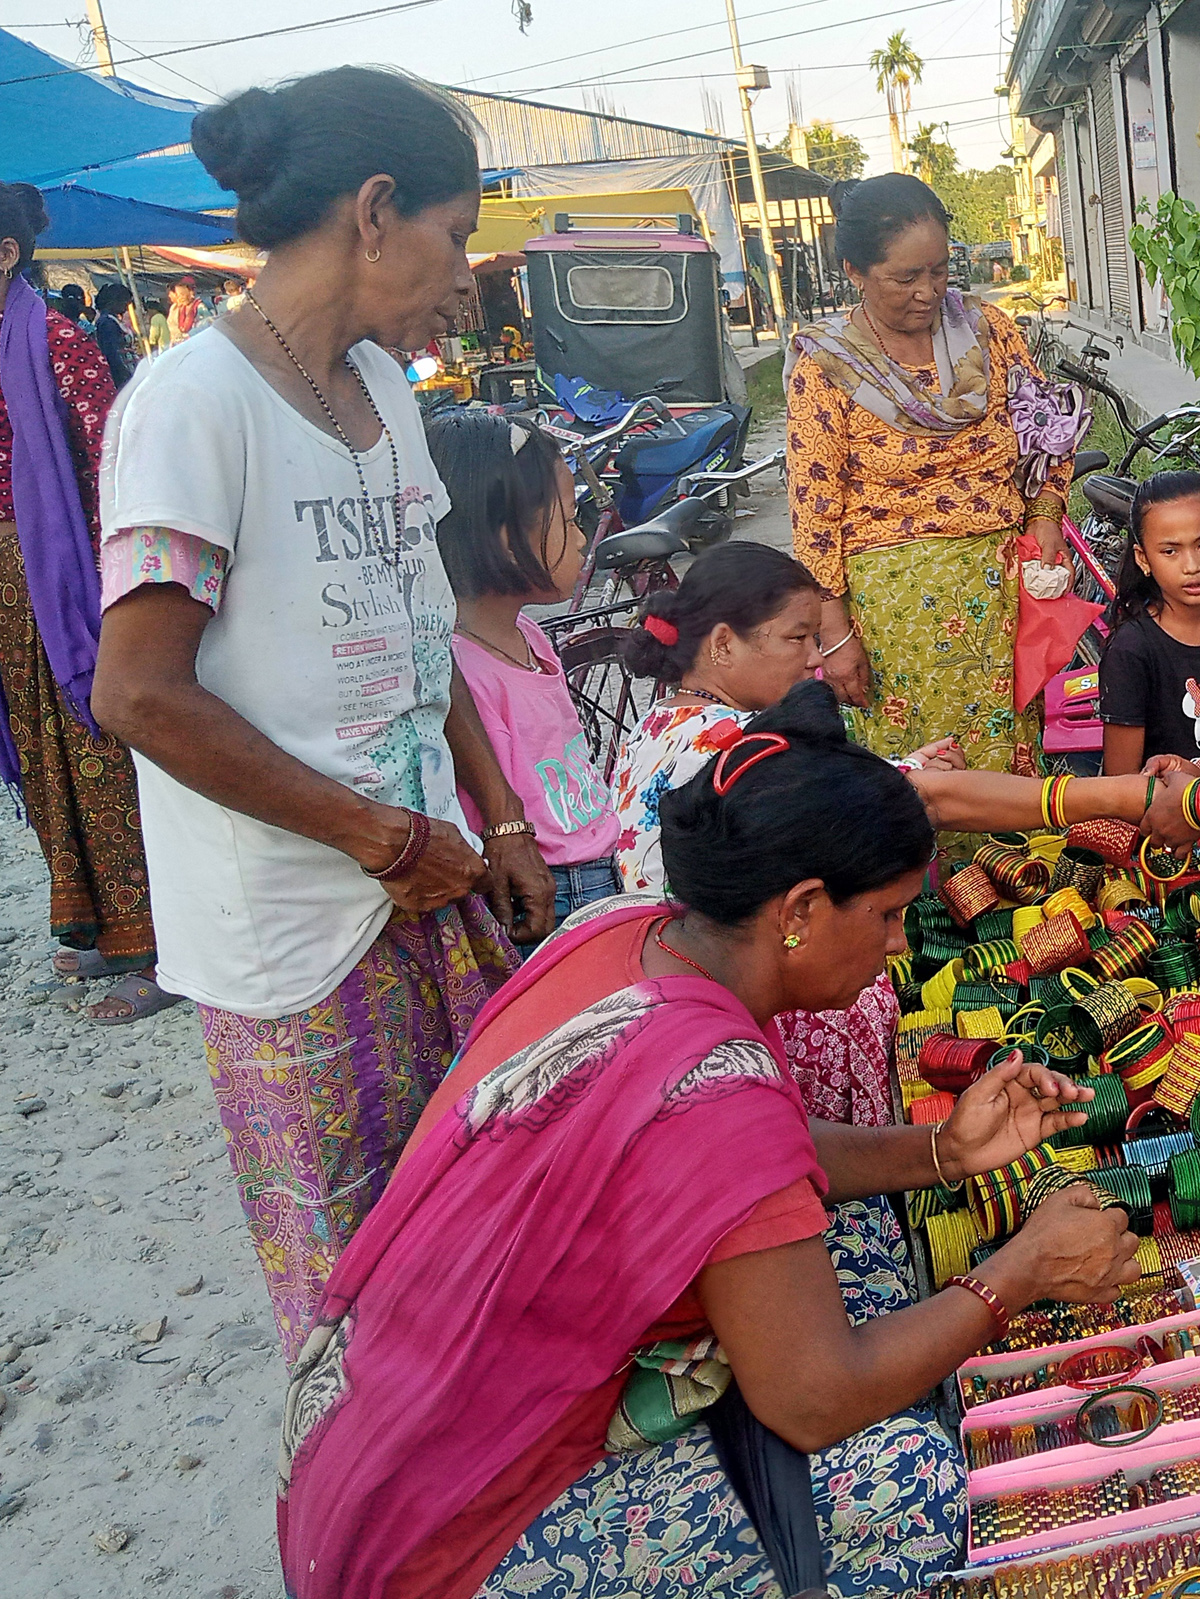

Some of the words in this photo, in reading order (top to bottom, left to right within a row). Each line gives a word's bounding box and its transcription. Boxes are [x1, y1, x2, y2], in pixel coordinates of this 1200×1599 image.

[321, 583, 401, 628] Stylish
[337, 675, 363, 685] WORLD
[343, 703, 357, 711] SEE
[360, 701, 373, 709] THE
